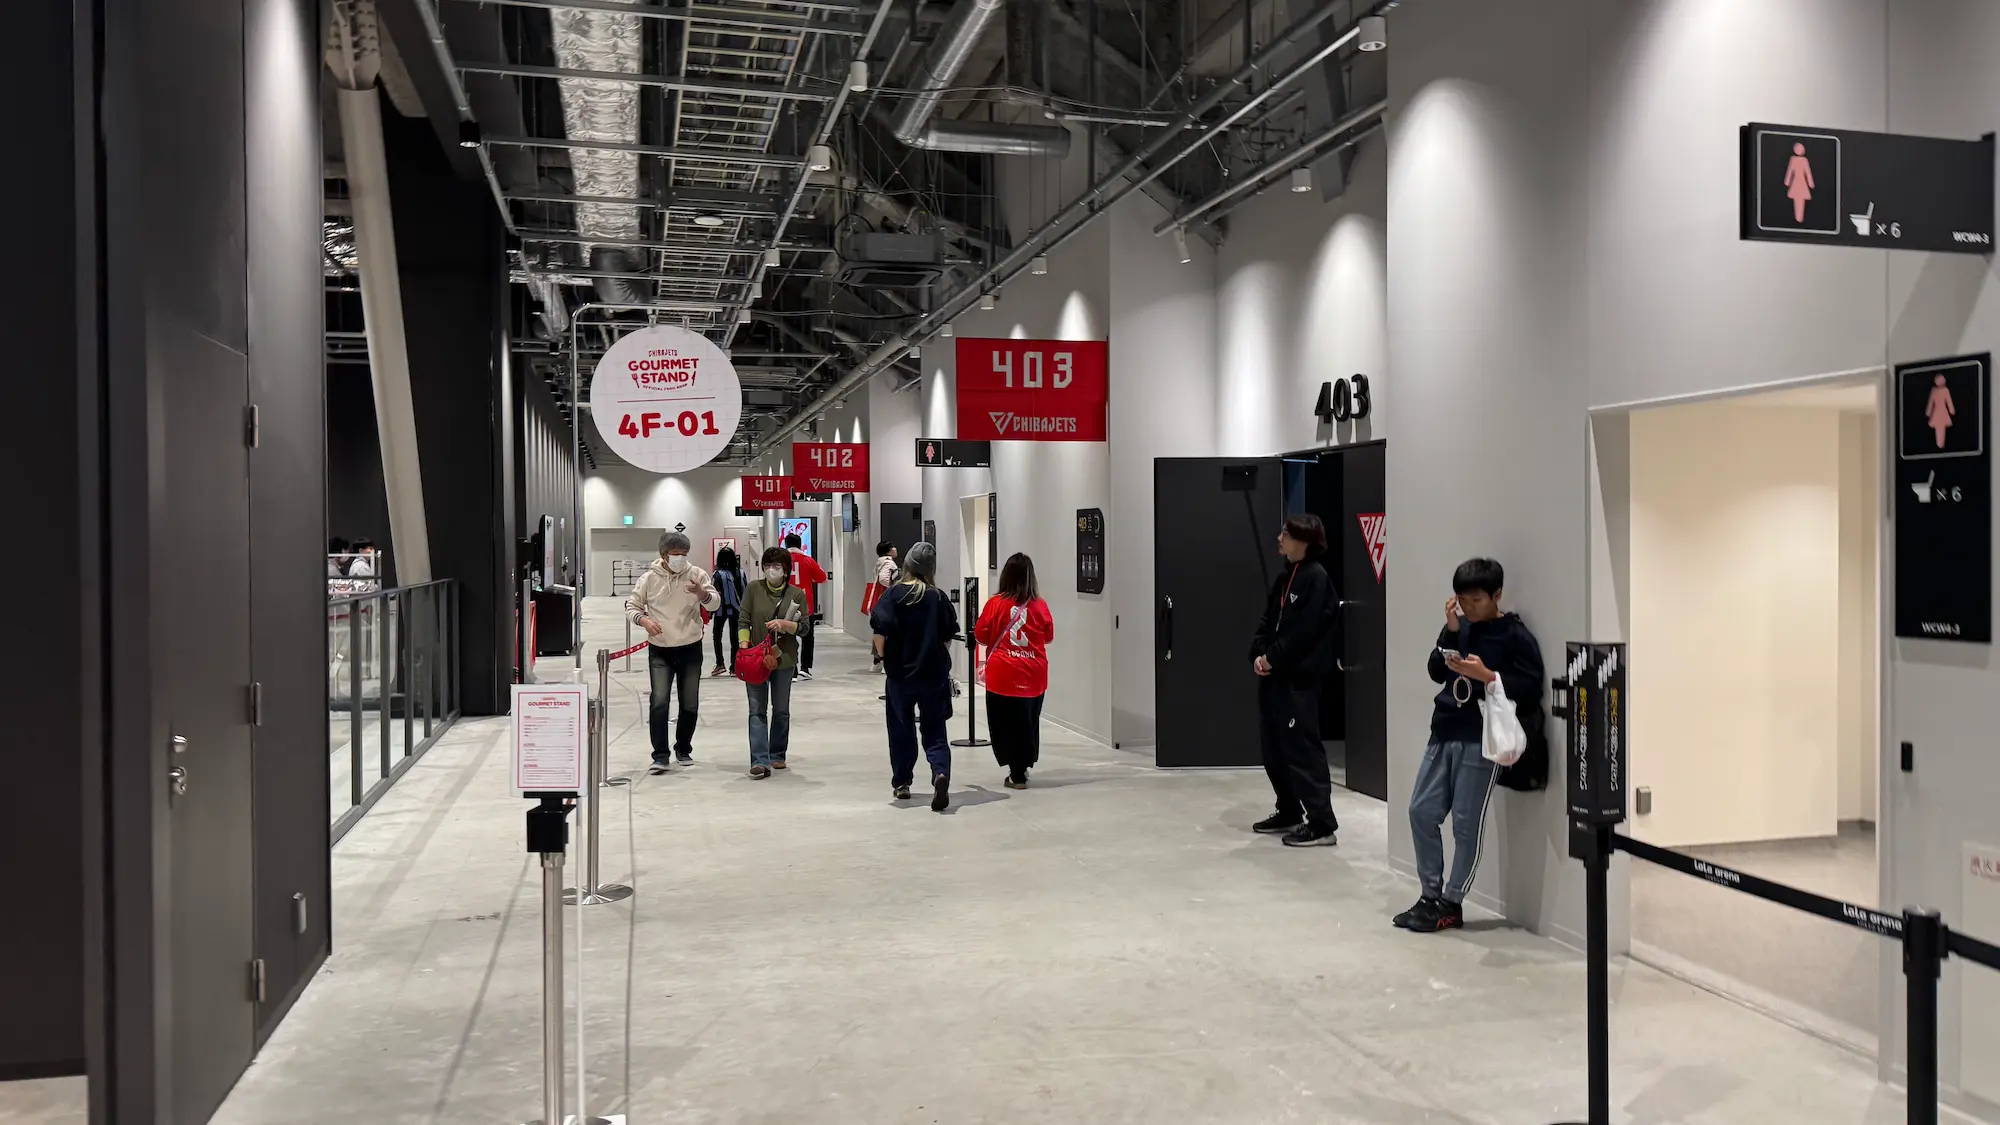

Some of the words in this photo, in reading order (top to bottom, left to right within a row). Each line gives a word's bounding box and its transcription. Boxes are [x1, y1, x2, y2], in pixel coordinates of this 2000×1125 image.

[628, 358, 700, 371] GOURMET
[992, 350, 1073, 389] 403
[641, 371, 689, 384] STAND
[1314, 373, 1370, 424] 403
[618, 410, 720, 439] 4F-01
[1013, 416, 1077, 432] CHIBAJETS
[810, 448, 853, 468] 402
[755, 479, 781, 493] 401
[821, 480, 855, 489] CHIBAJETS
[1714, 867, 1740, 884] arena
[1869, 913, 1903, 932] arena
